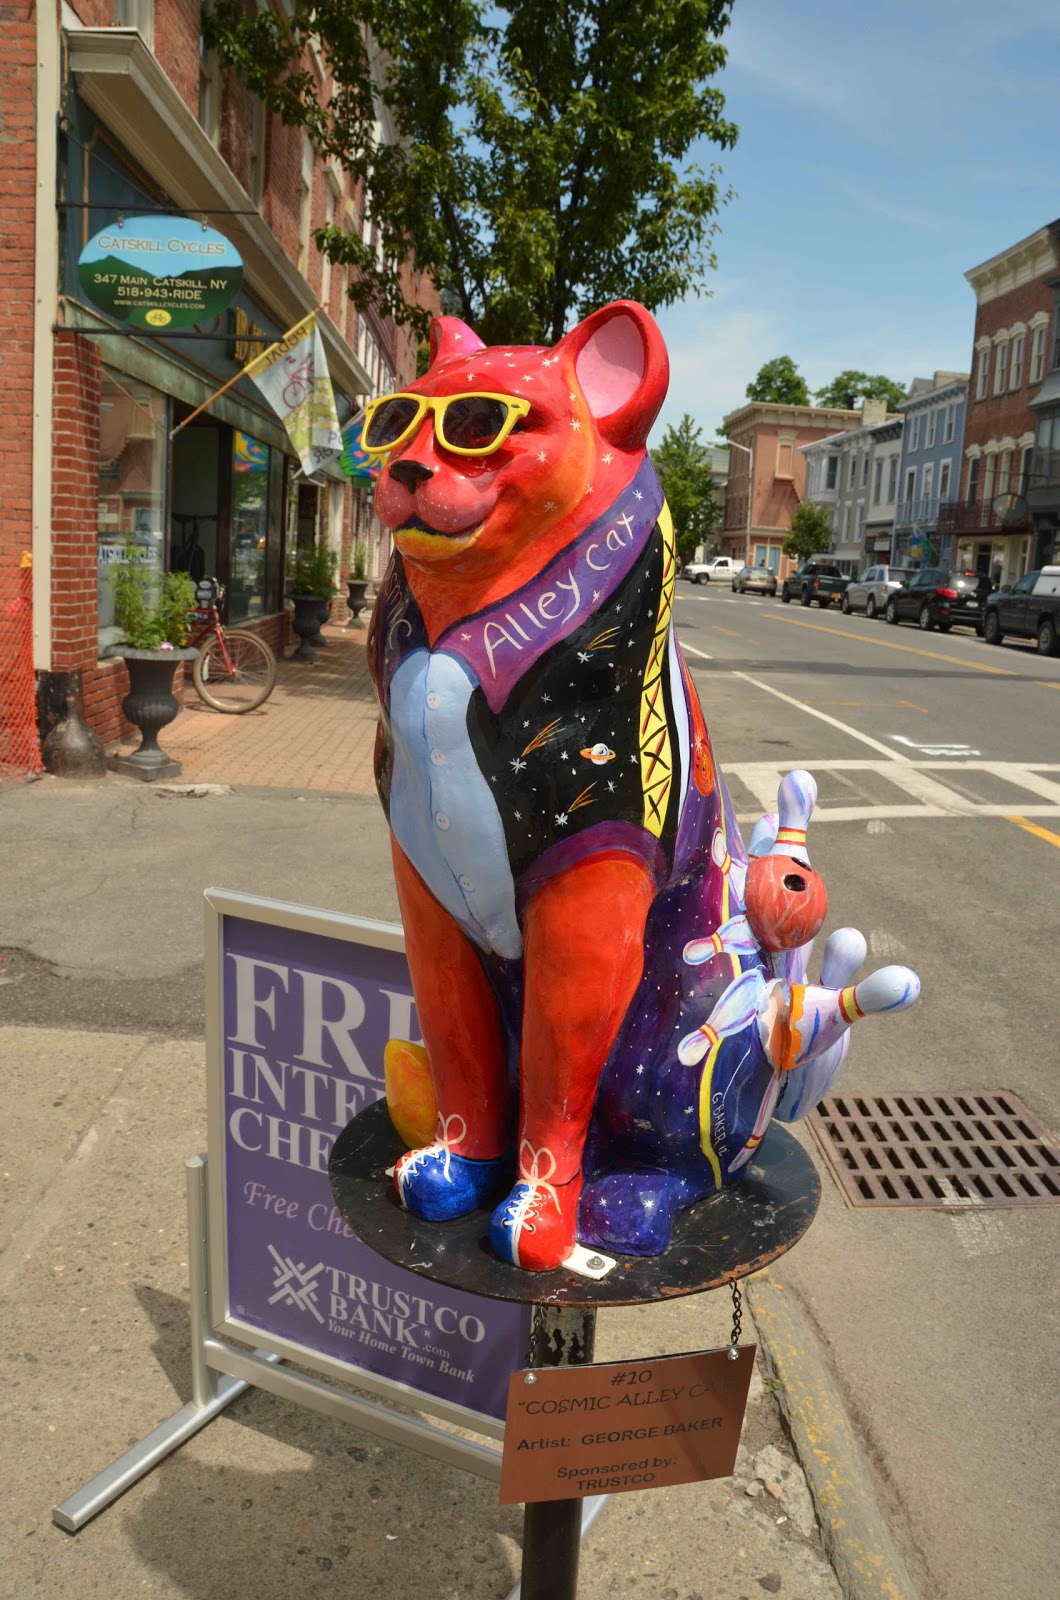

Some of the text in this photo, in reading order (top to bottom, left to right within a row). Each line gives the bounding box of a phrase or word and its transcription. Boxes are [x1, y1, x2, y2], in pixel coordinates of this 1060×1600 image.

[98, 236, 225, 255] CATSKILL CYCLES
[94, 274, 228, 290] 347 MAIN CATSKILL, NY
[484, 568, 582, 681] Alley
[228, 1047, 386, 1128] INTE
[243, 1181, 362, 1242] Free Che
[325, 1266, 486, 1343] TRUSTCO
[329, 1293, 420, 1348] BANK
[327, 1319, 475, 1384] Your Home Town Bank
[422, 1344, 450, 1360] .com
[611, 1369, 653, 1386] #10
[616, 1386, 686, 1407] ALLEY
[517, 1417, 723, 1451] Artist: GEORGE BAKER
[557, 1455, 679, 1481] Sponsored by:
[576, 1472, 656, 1491] TRUSTCO
